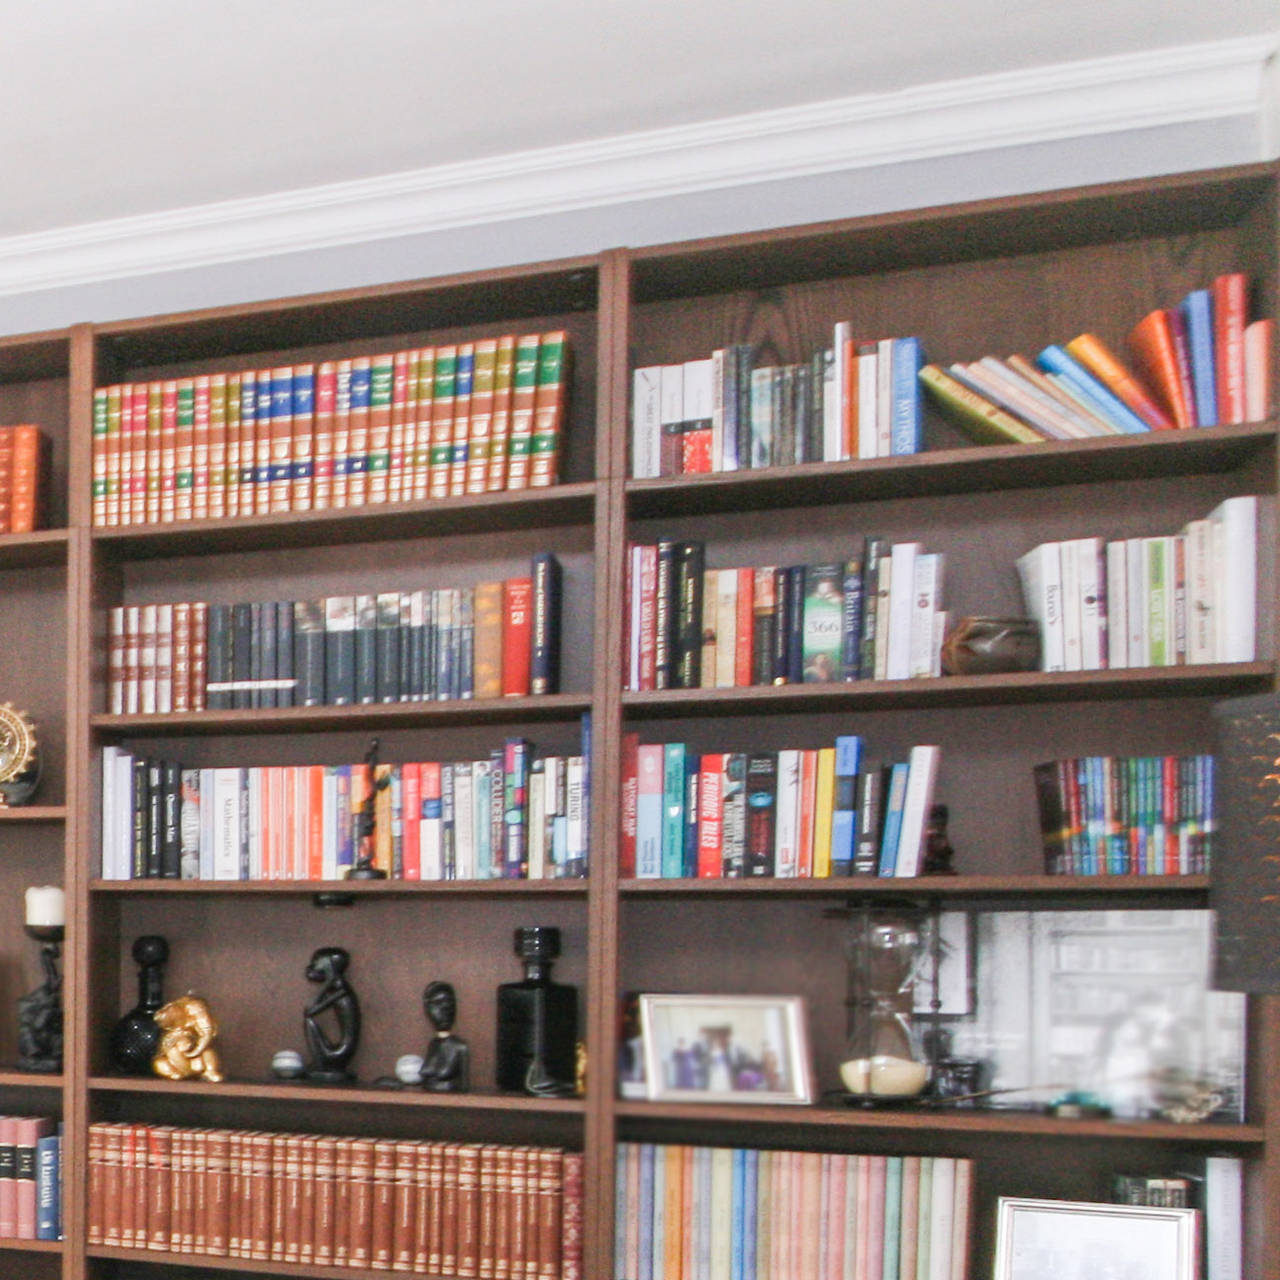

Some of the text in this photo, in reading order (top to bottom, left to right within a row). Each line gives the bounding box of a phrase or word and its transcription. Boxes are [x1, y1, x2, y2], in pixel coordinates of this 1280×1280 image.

[492, 769, 503, 823] COLLIDER
[570, 782, 581, 822] TURING
[701, 772, 719, 849] PERIODIC TALES
[224, 798, 233, 858] Mathematics
